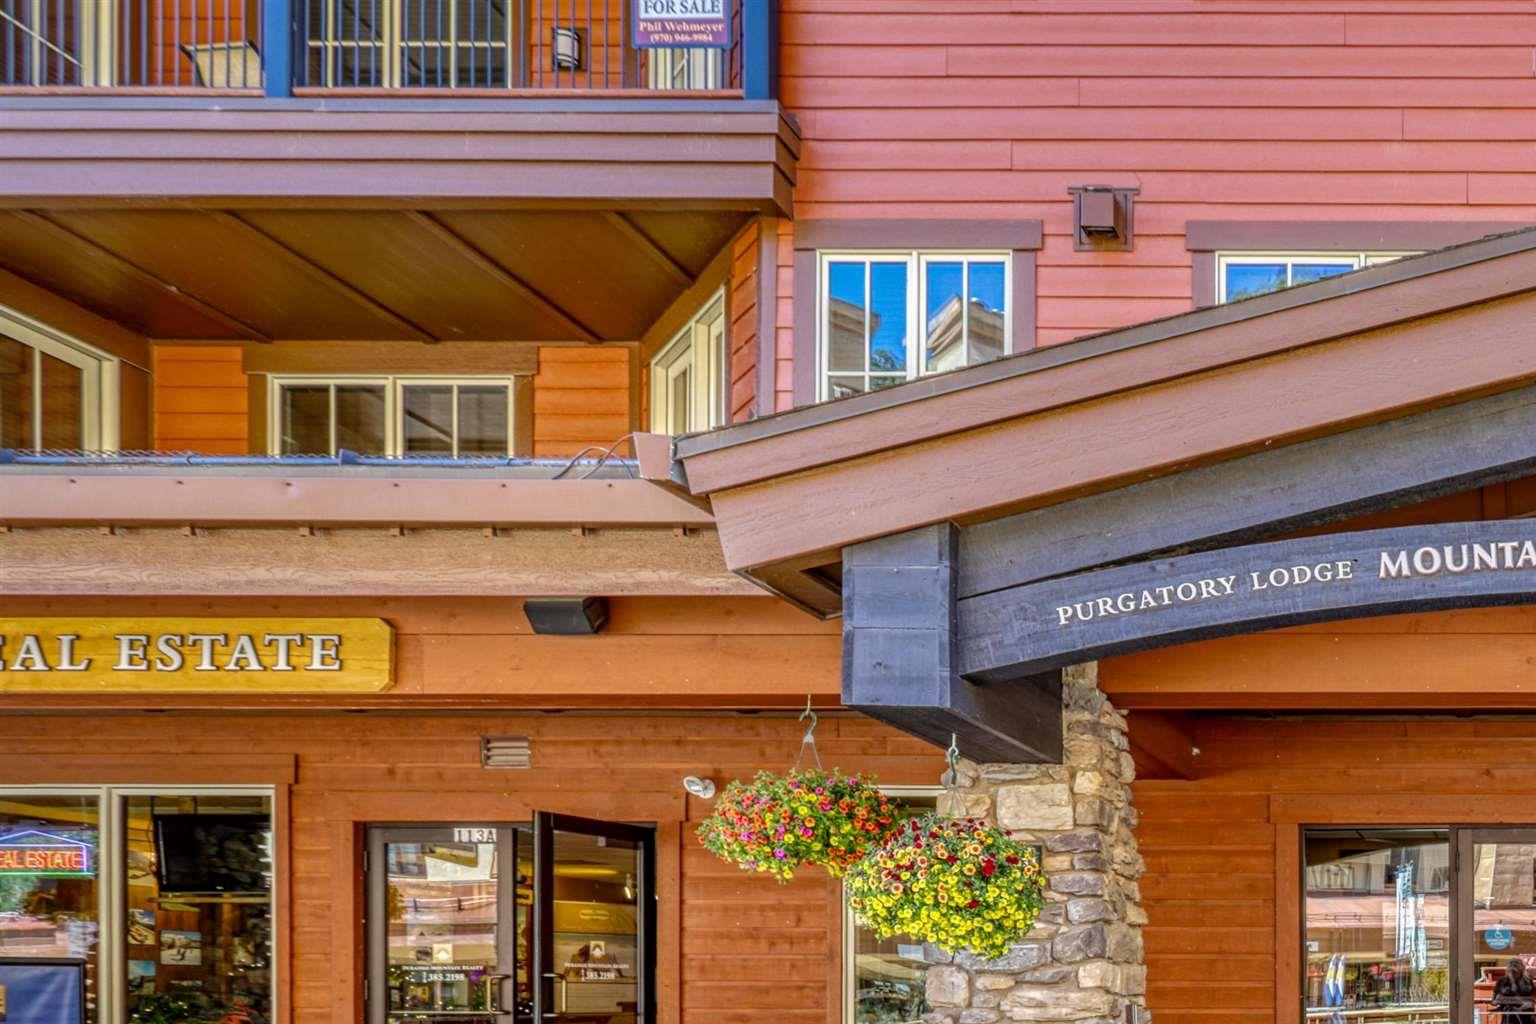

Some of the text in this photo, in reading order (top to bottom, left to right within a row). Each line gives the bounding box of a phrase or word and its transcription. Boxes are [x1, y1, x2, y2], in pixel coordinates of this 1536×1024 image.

[644, 0, 720, 14] FOR SALE
[640, 22, 662, 31] Phil
[1056, 574, 1237, 625] PURGATORY
[1251, 560, 1354, 592] LODGE
[0, 633, 342, 671] AL ESTATE
[457, 829, 495, 842] 113A
[26, 850, 84, 868] ESTATE
